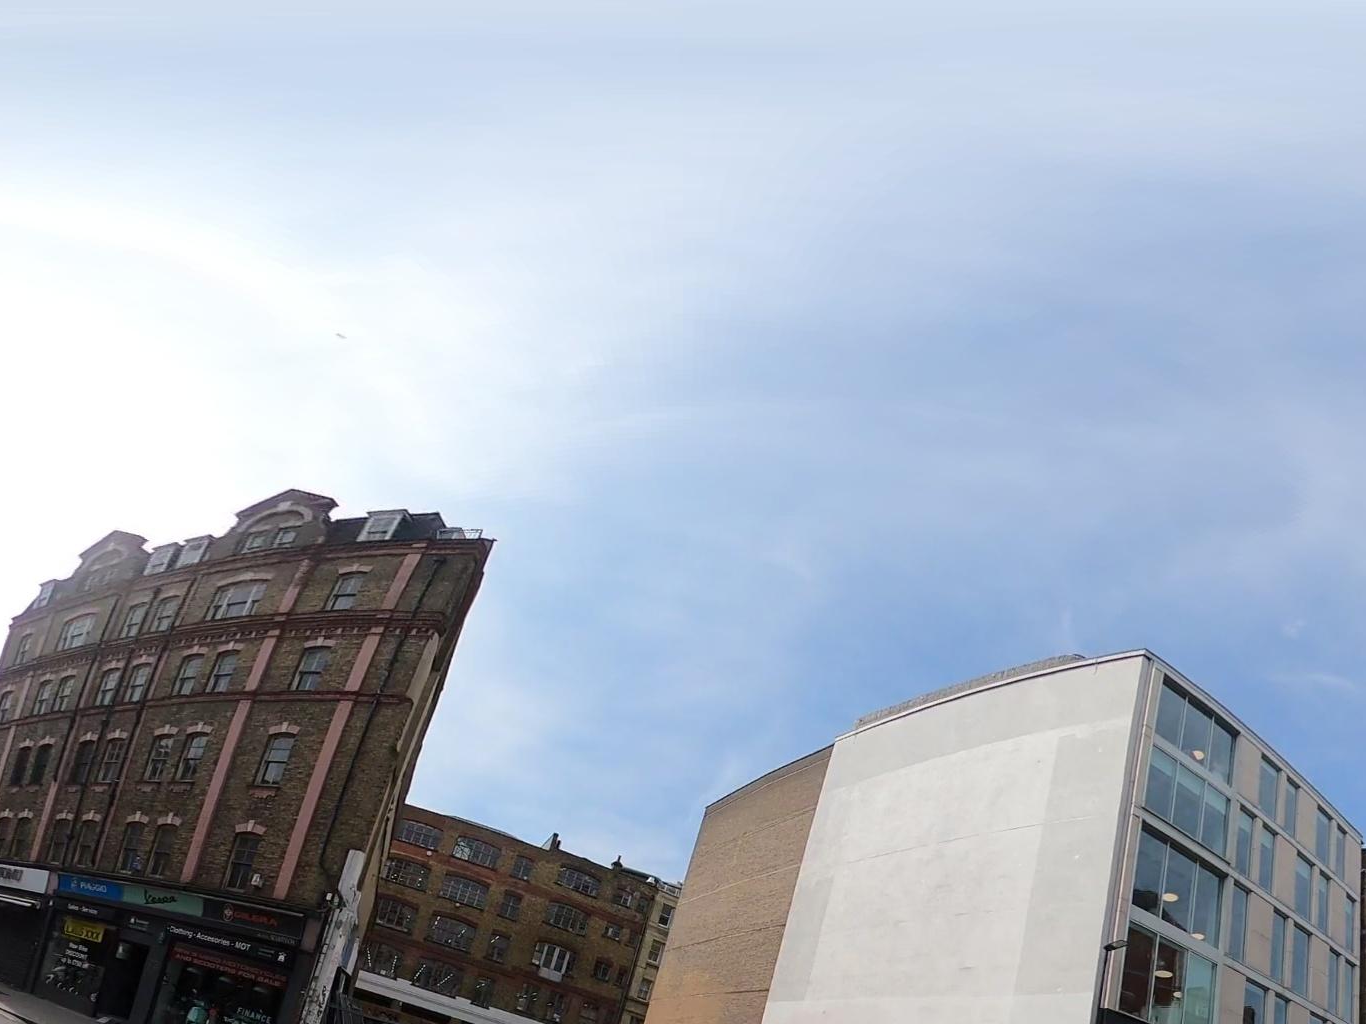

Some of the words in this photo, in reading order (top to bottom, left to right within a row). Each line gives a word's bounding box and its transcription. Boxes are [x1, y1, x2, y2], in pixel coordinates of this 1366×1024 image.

[80, 881, 107, 893] PIAGGIO
[144, 889, 177, 905] Vespa
[169, 925, 193, 939] Clothing
[235, 941, 251, 951] MOT
[176, 953, 192, 962] AND
[194, 957, 235, 975] SCOOTERS
[238, 970, 255, 980] FOR
[258, 976, 283, 987] SALE
[236, 1007, 272, 1024] FINANCE
